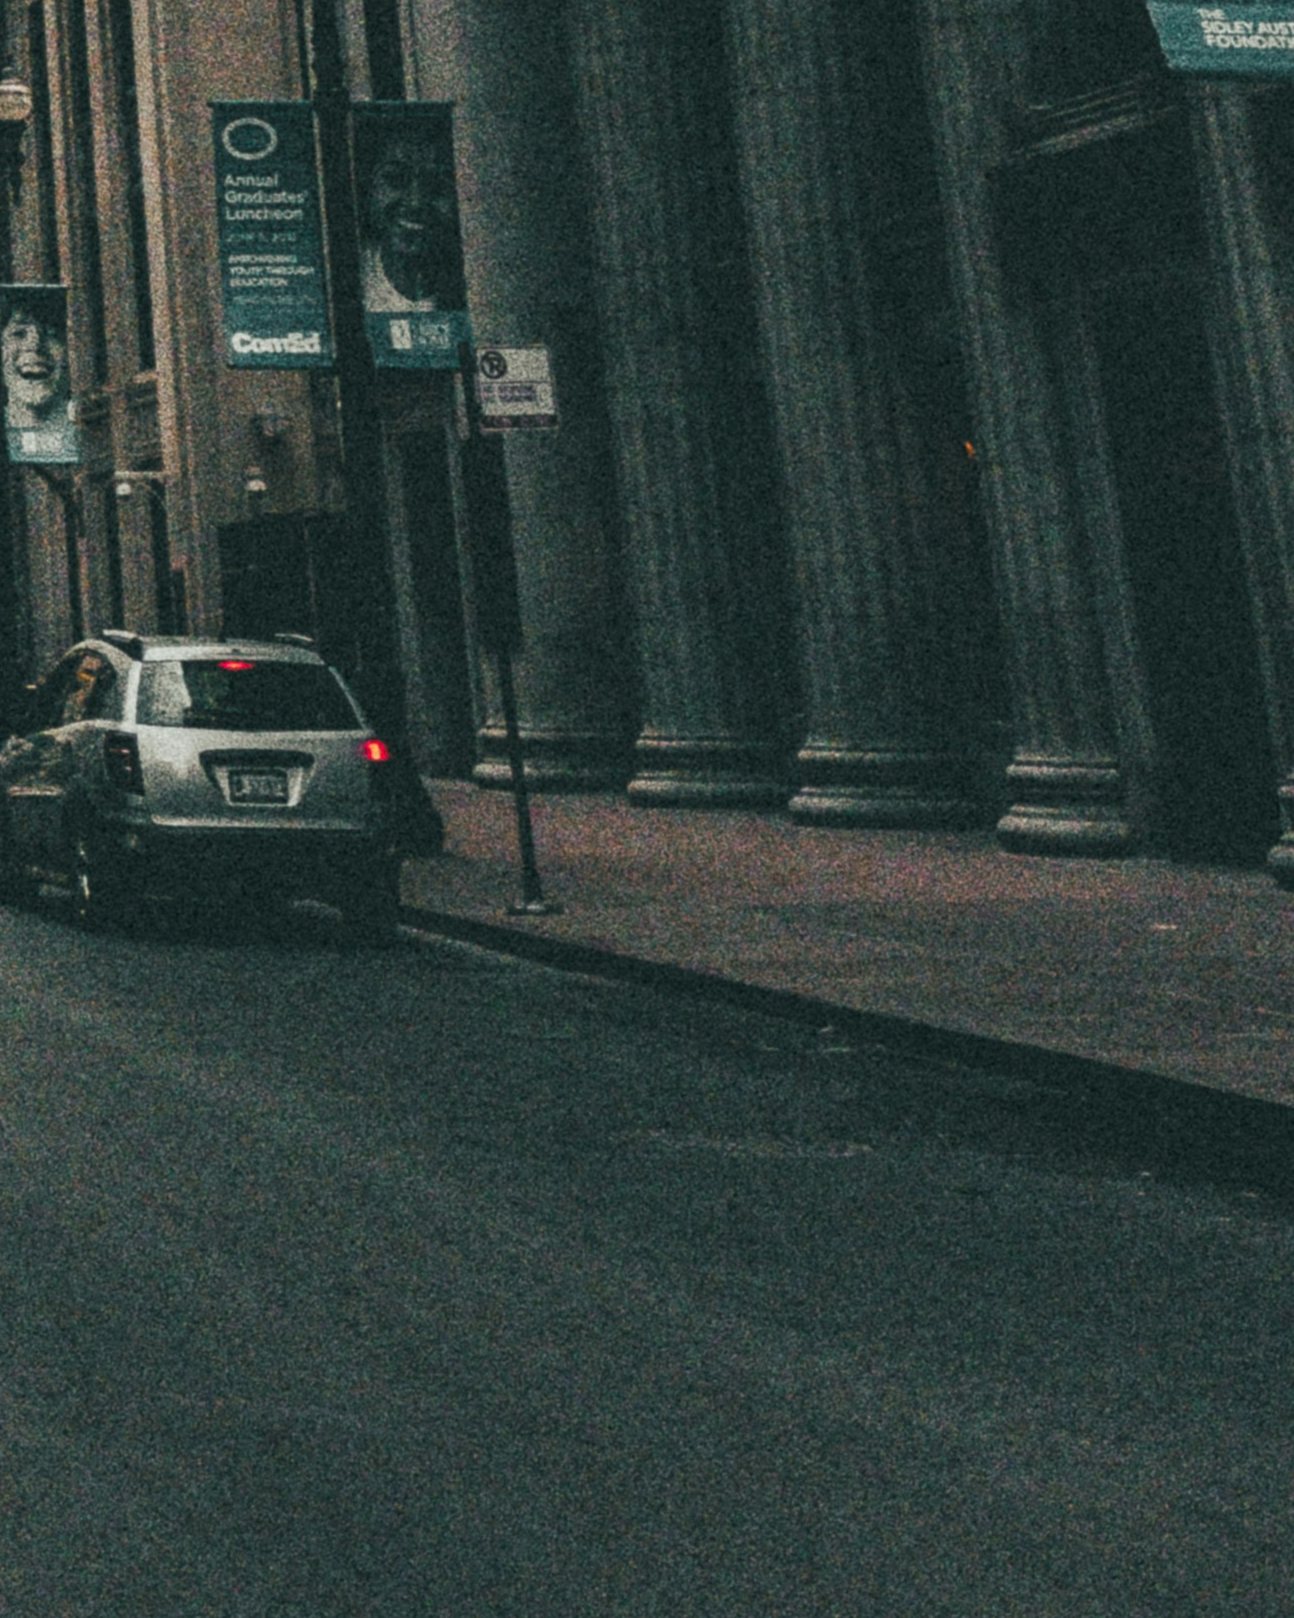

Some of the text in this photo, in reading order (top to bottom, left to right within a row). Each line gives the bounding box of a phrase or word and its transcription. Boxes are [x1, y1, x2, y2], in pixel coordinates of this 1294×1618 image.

[224, 172, 279, 187] Annual
[225, 206, 304, 221] Luncheon
[231, 330, 322, 354] ComEd
